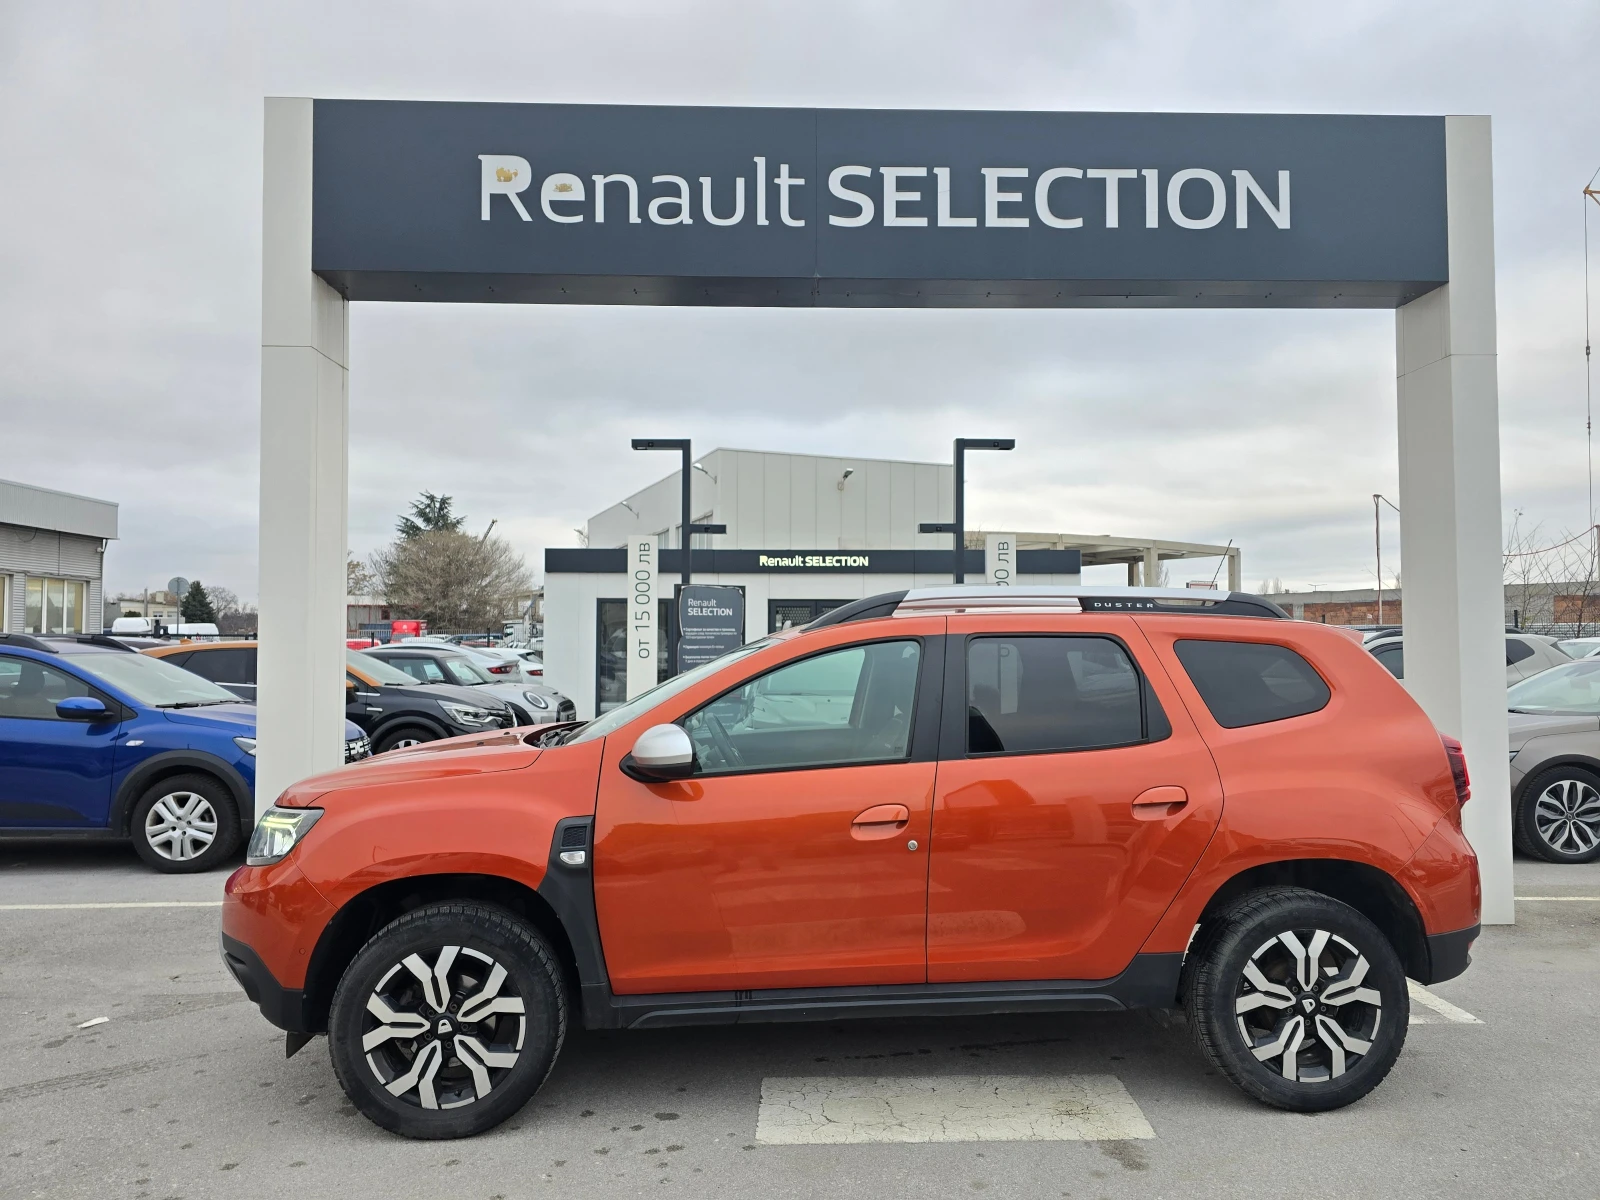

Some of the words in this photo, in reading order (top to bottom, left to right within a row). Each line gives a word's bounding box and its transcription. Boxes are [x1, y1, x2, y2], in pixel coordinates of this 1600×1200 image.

[477, 154, 806, 227] Renault
[828, 165, 1292, 230] SELECTION
[759, 555, 803, 567] Renault
[805, 556, 869, 567] SELECTION
[635, 570, 651, 605] 000
[688, 598, 717, 607] Renault
[687, 607, 733, 616] SELECTION
[635, 610, 651, 632] 15
